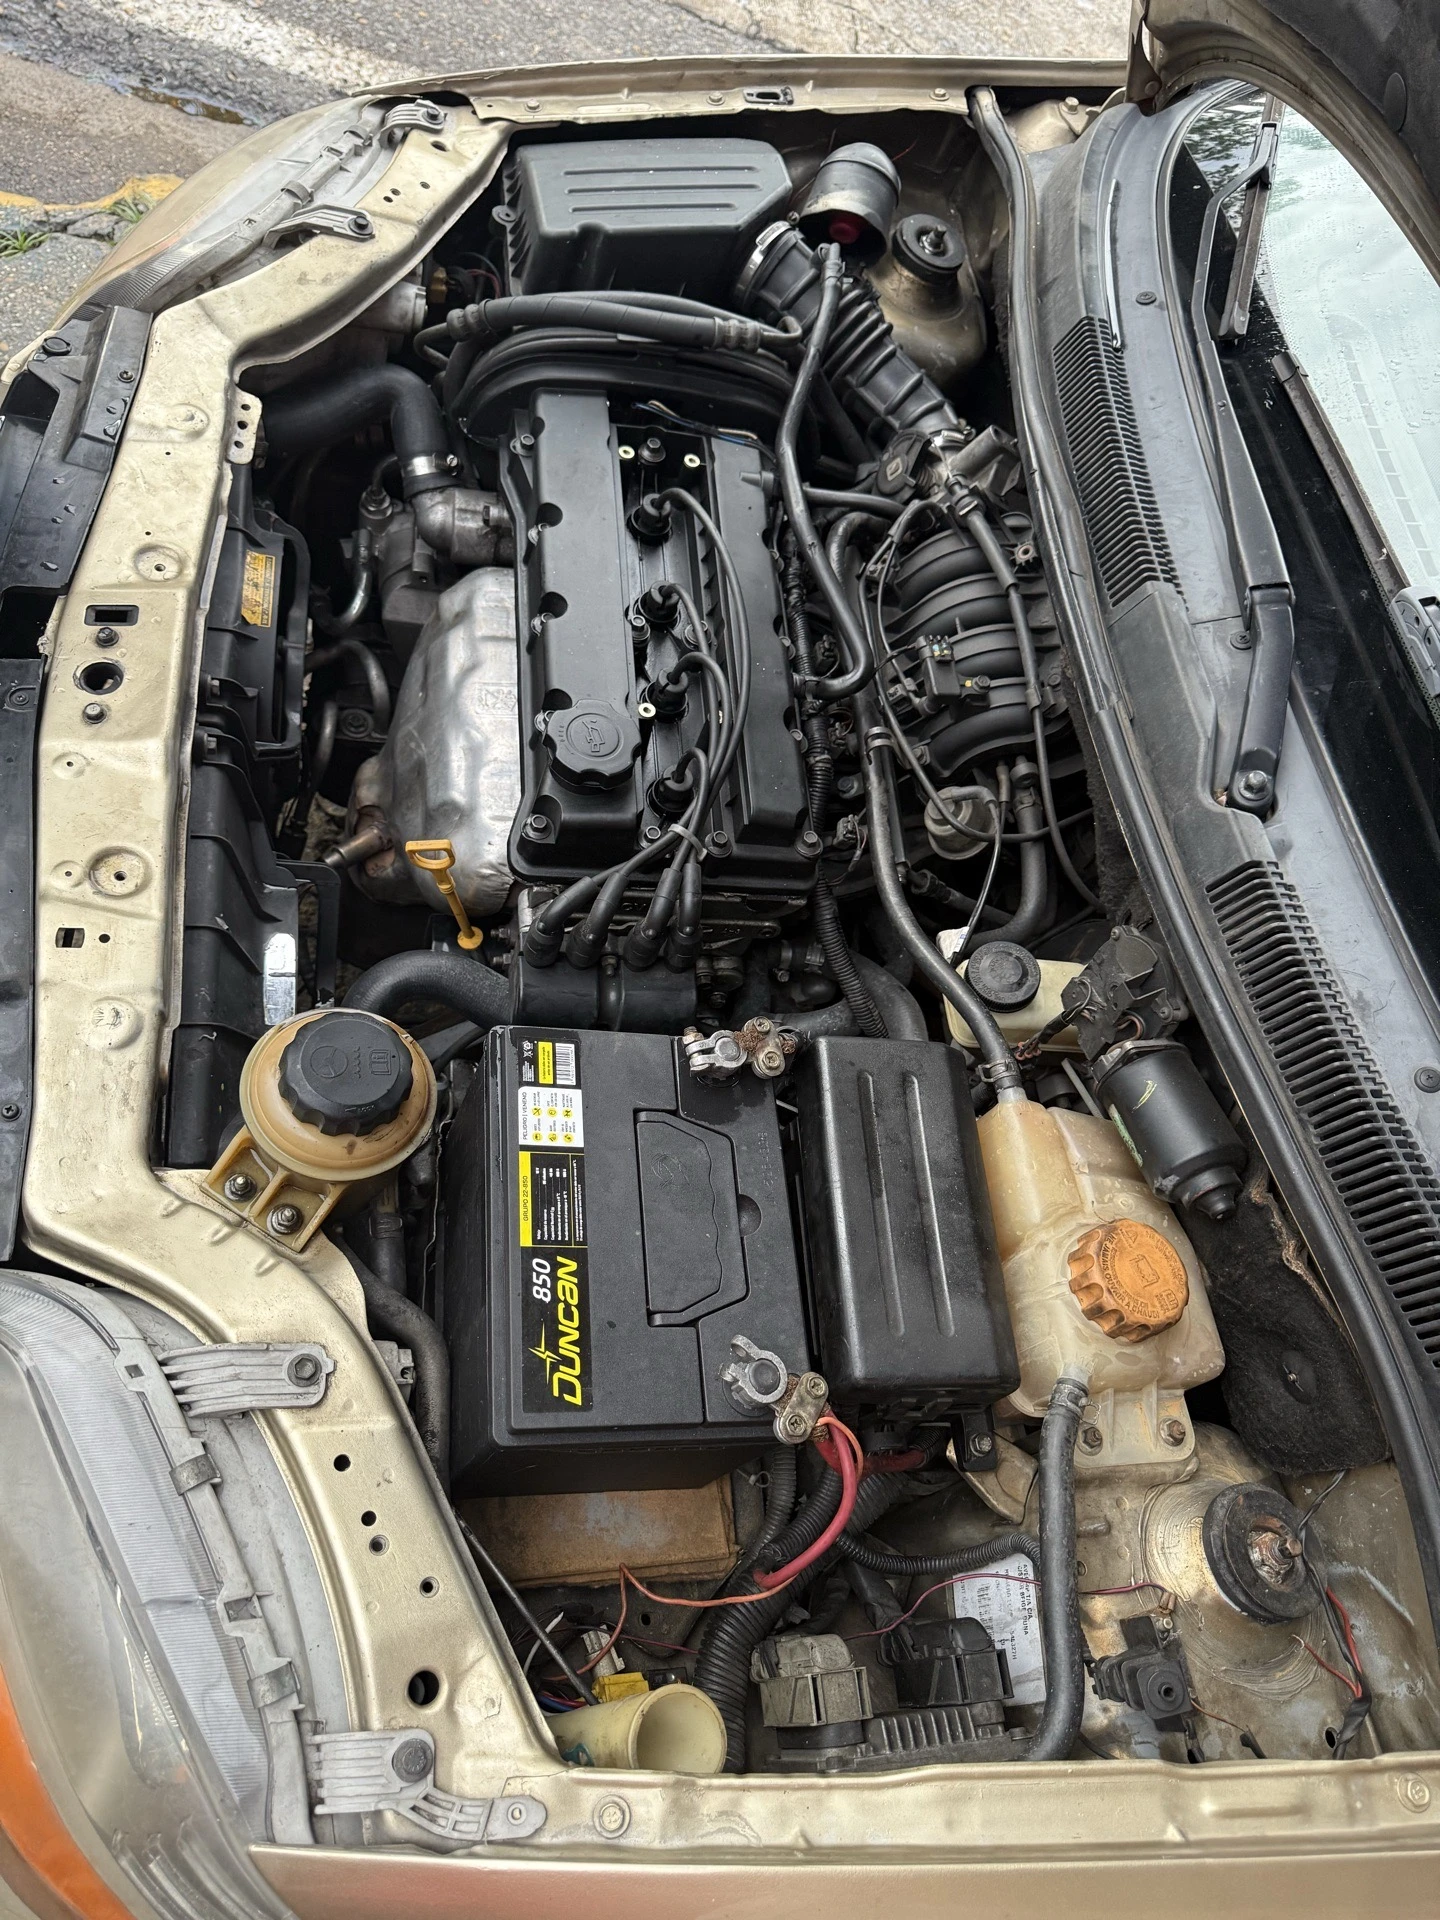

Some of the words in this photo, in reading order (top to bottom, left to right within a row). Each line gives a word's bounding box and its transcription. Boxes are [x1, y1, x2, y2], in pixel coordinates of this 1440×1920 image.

[532, 1257, 552, 1303] 850
[1104, 1271, 1127, 1303] OUVRIR
[1021, 1615, 1029, 1636] DUNA
